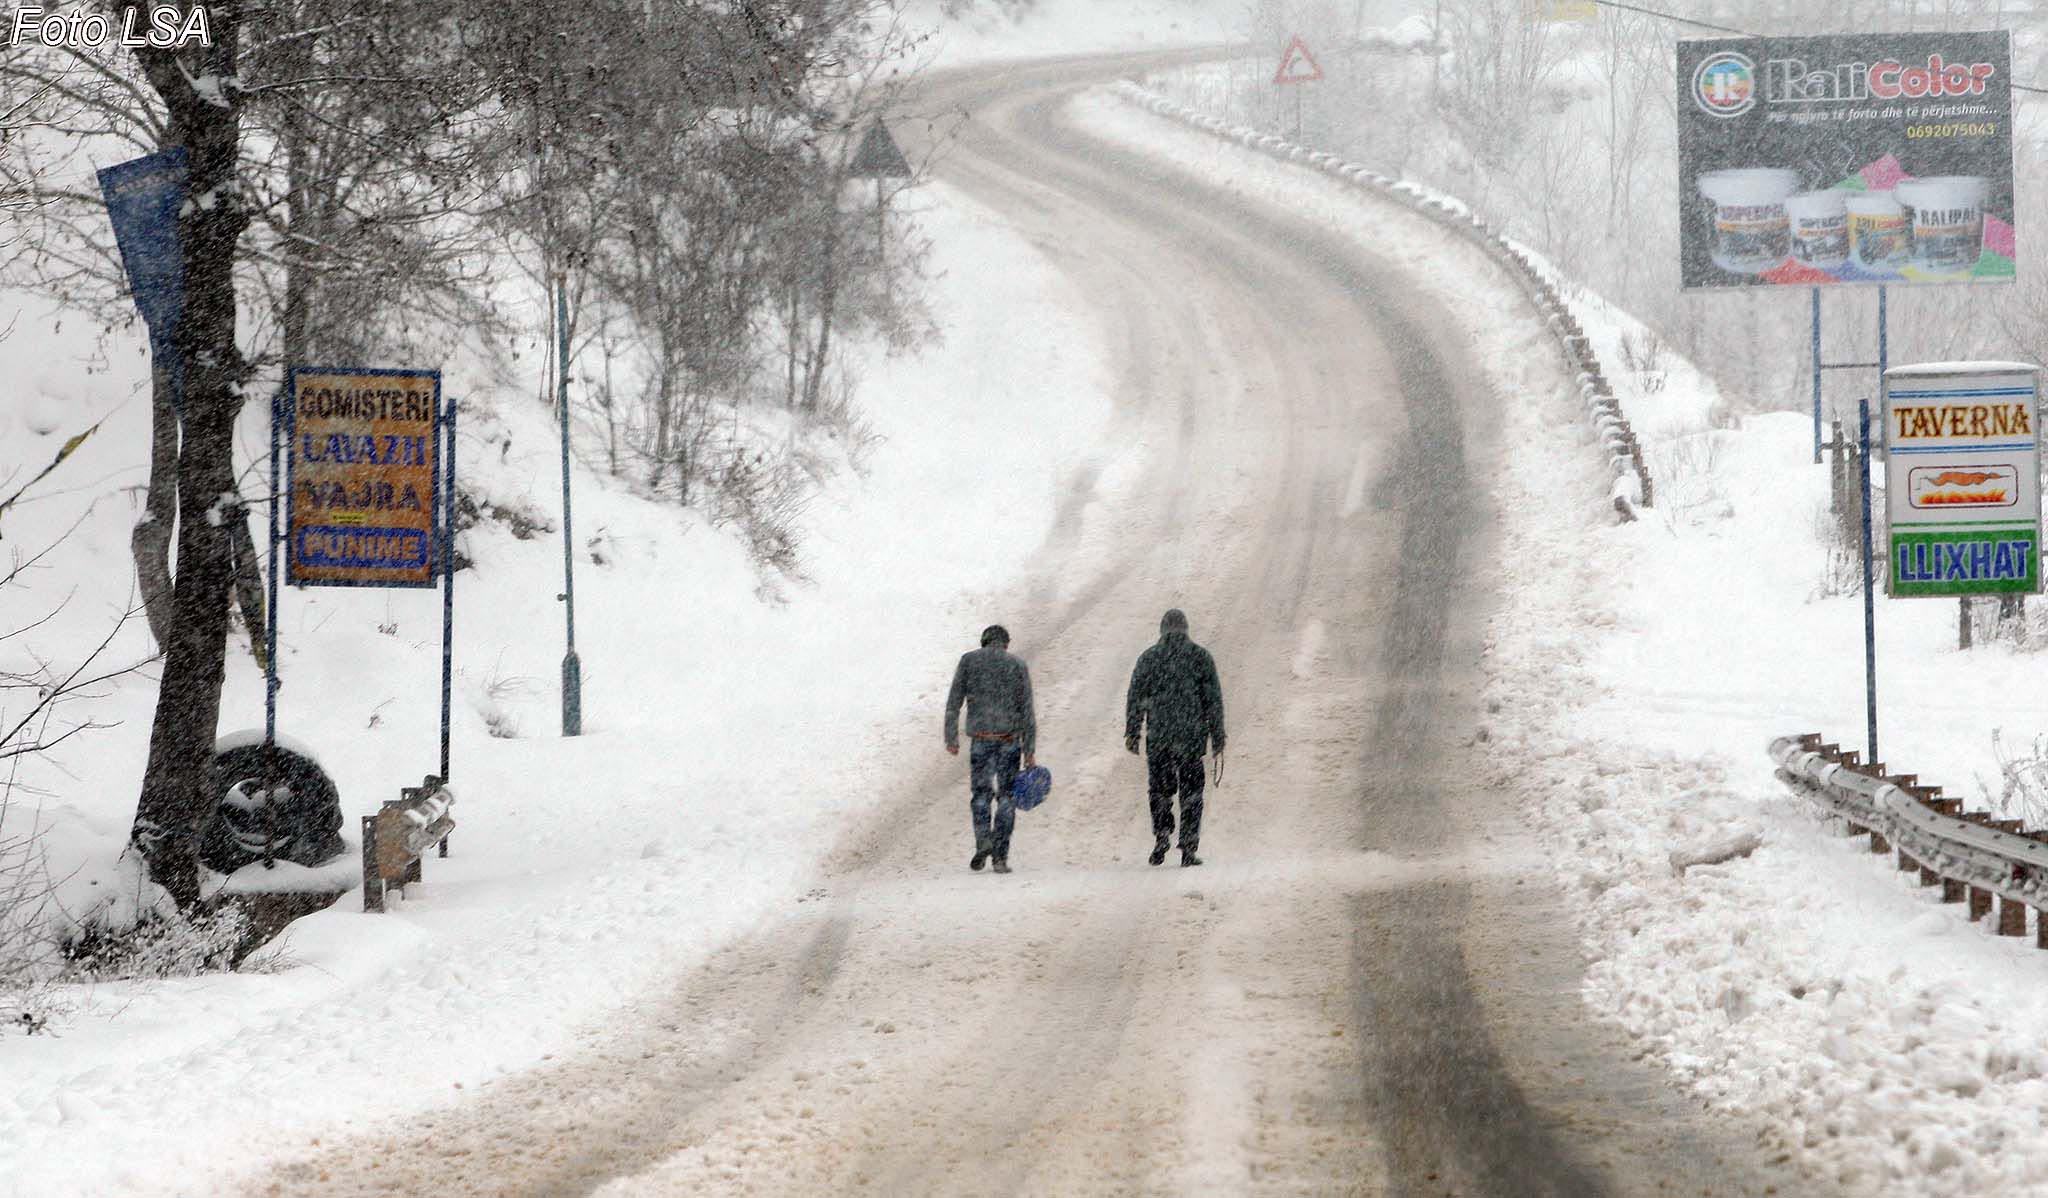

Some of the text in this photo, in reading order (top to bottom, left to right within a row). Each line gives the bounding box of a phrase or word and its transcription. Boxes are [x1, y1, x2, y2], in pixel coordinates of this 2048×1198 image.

[1847, 108, 1878, 123] forta
[1881, 106, 1903, 119] dhe
[1906, 106, 1920, 116] të
[1921, 102, 1997, 119] përjetshme...
[1907, 122, 1996, 139] 0692075043
[300, 387, 430, 422] GOMISTERI
[1893, 403, 2033, 439] TAVERNA
[302, 433, 427, 466] LAVAZH
[302, 479, 422, 512] VAJRA
[304, 533, 421, 562] PUNIME
[1898, 540, 2032, 582] LLIXHAT
